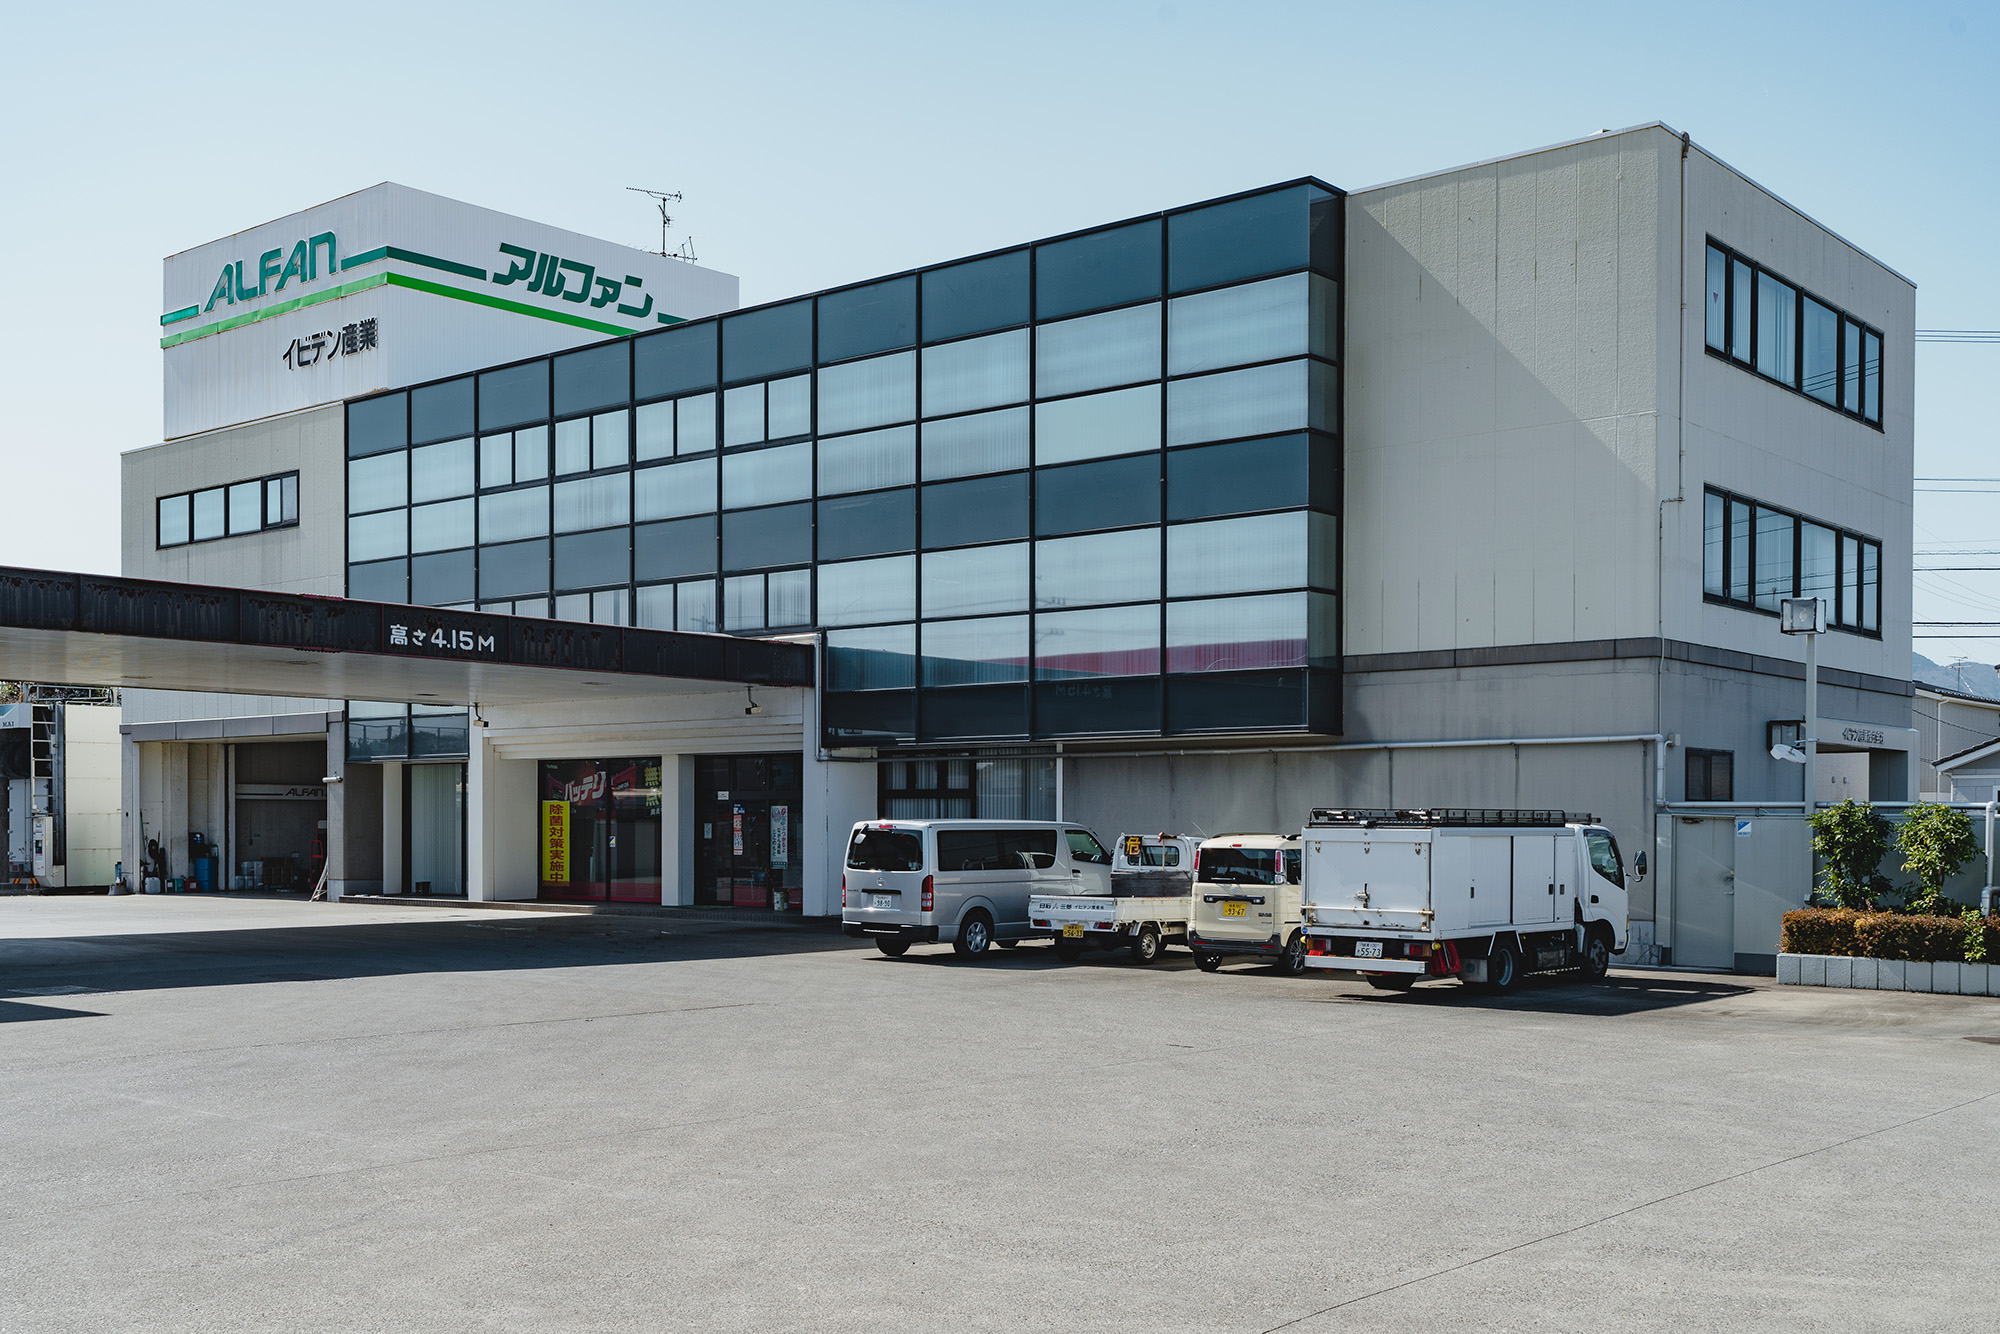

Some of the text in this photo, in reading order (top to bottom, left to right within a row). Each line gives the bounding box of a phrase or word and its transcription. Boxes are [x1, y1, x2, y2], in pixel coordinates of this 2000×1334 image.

[203, 230, 337, 313] ALFAN
[492, 242, 654, 318] アルファン
[283, 317, 377, 370] イビデン産業
[564, 771, 613, 804] バッテリ
[549, 803, 565, 883] 除菌対策実施中
[1125, 836, 1141, 855] 危
[1360, 947, 1382, 957] 55-73
